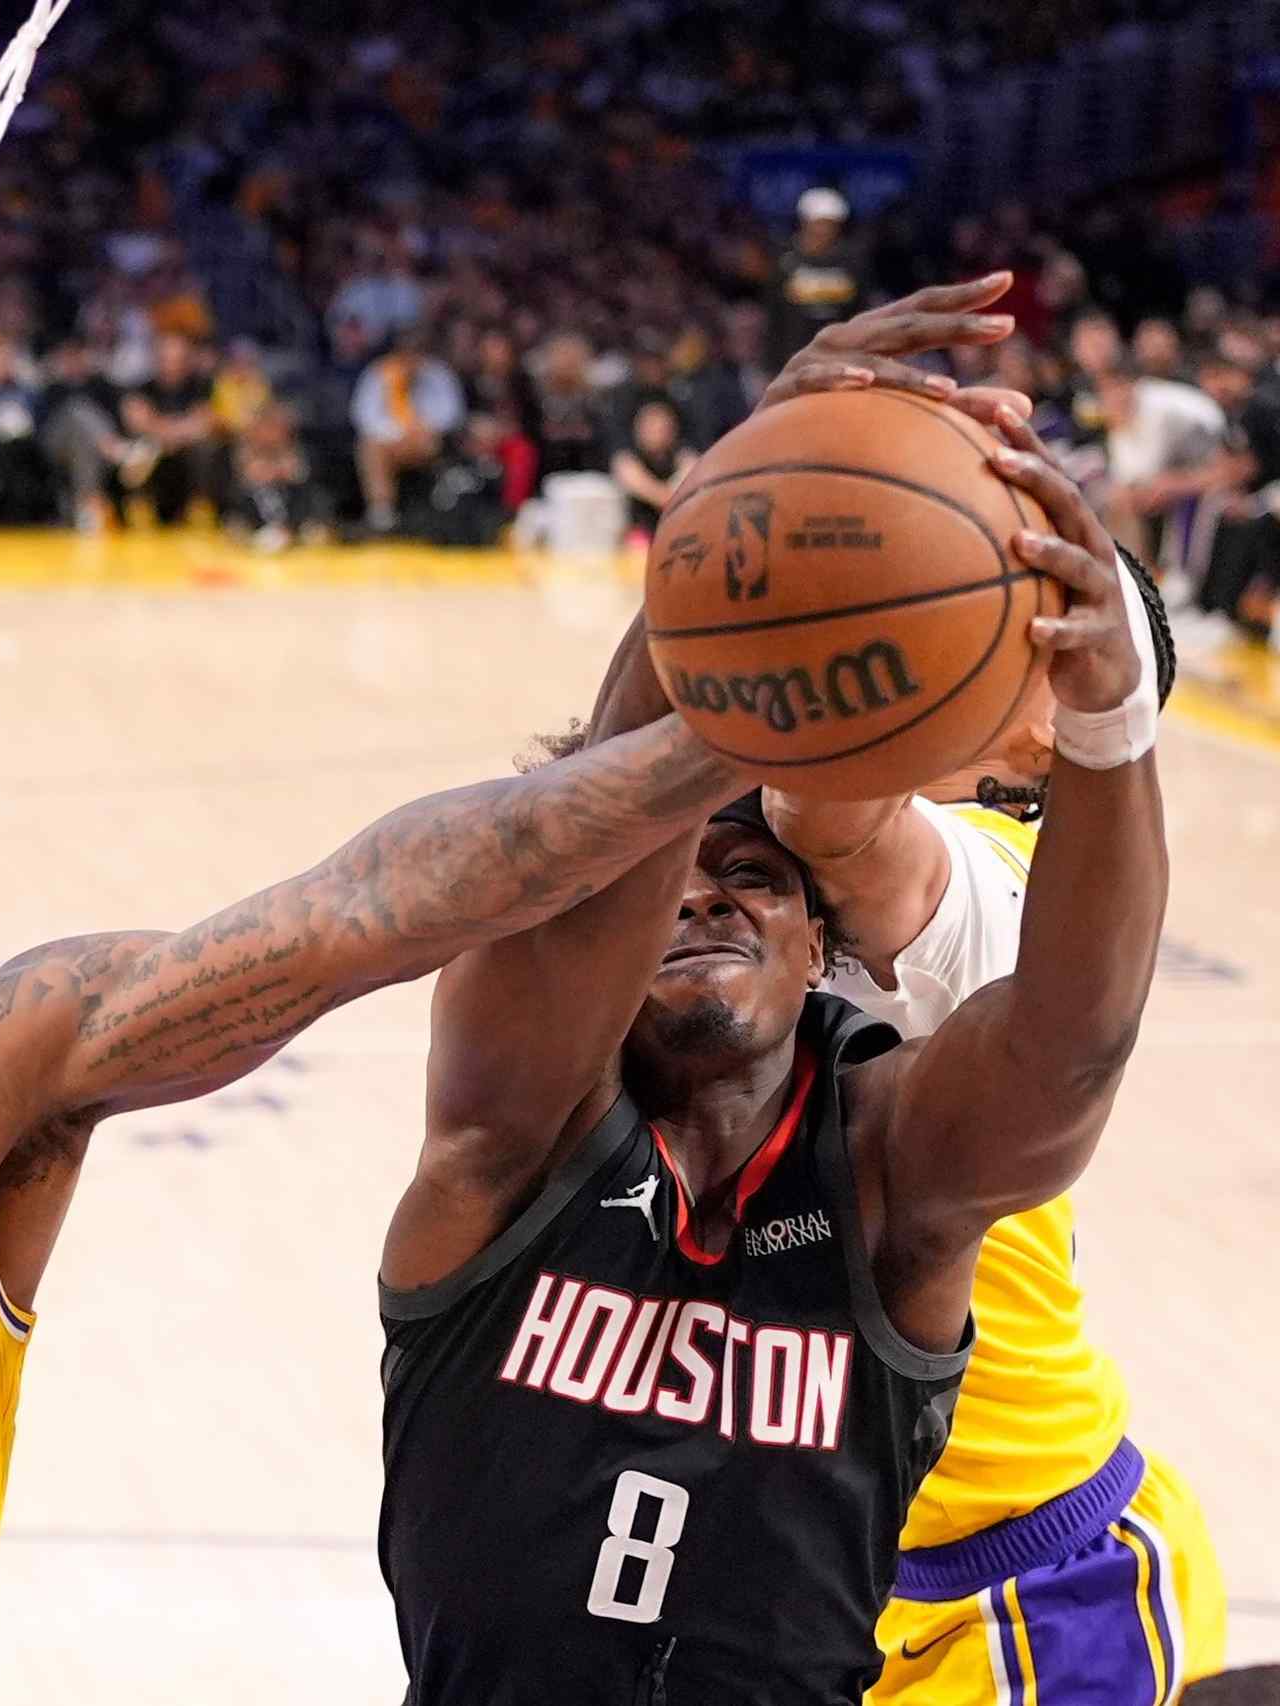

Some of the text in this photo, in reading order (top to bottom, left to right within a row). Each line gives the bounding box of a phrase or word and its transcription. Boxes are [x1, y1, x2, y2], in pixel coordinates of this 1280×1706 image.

[676, 639, 920, 734] Wilson
[745, 1209, 829, 1243] EMORIAL
[745, 1225, 832, 1256] ERMANN
[499, 1272, 852, 1450] HOUSTON
[587, 1470, 690, 1624] 8
